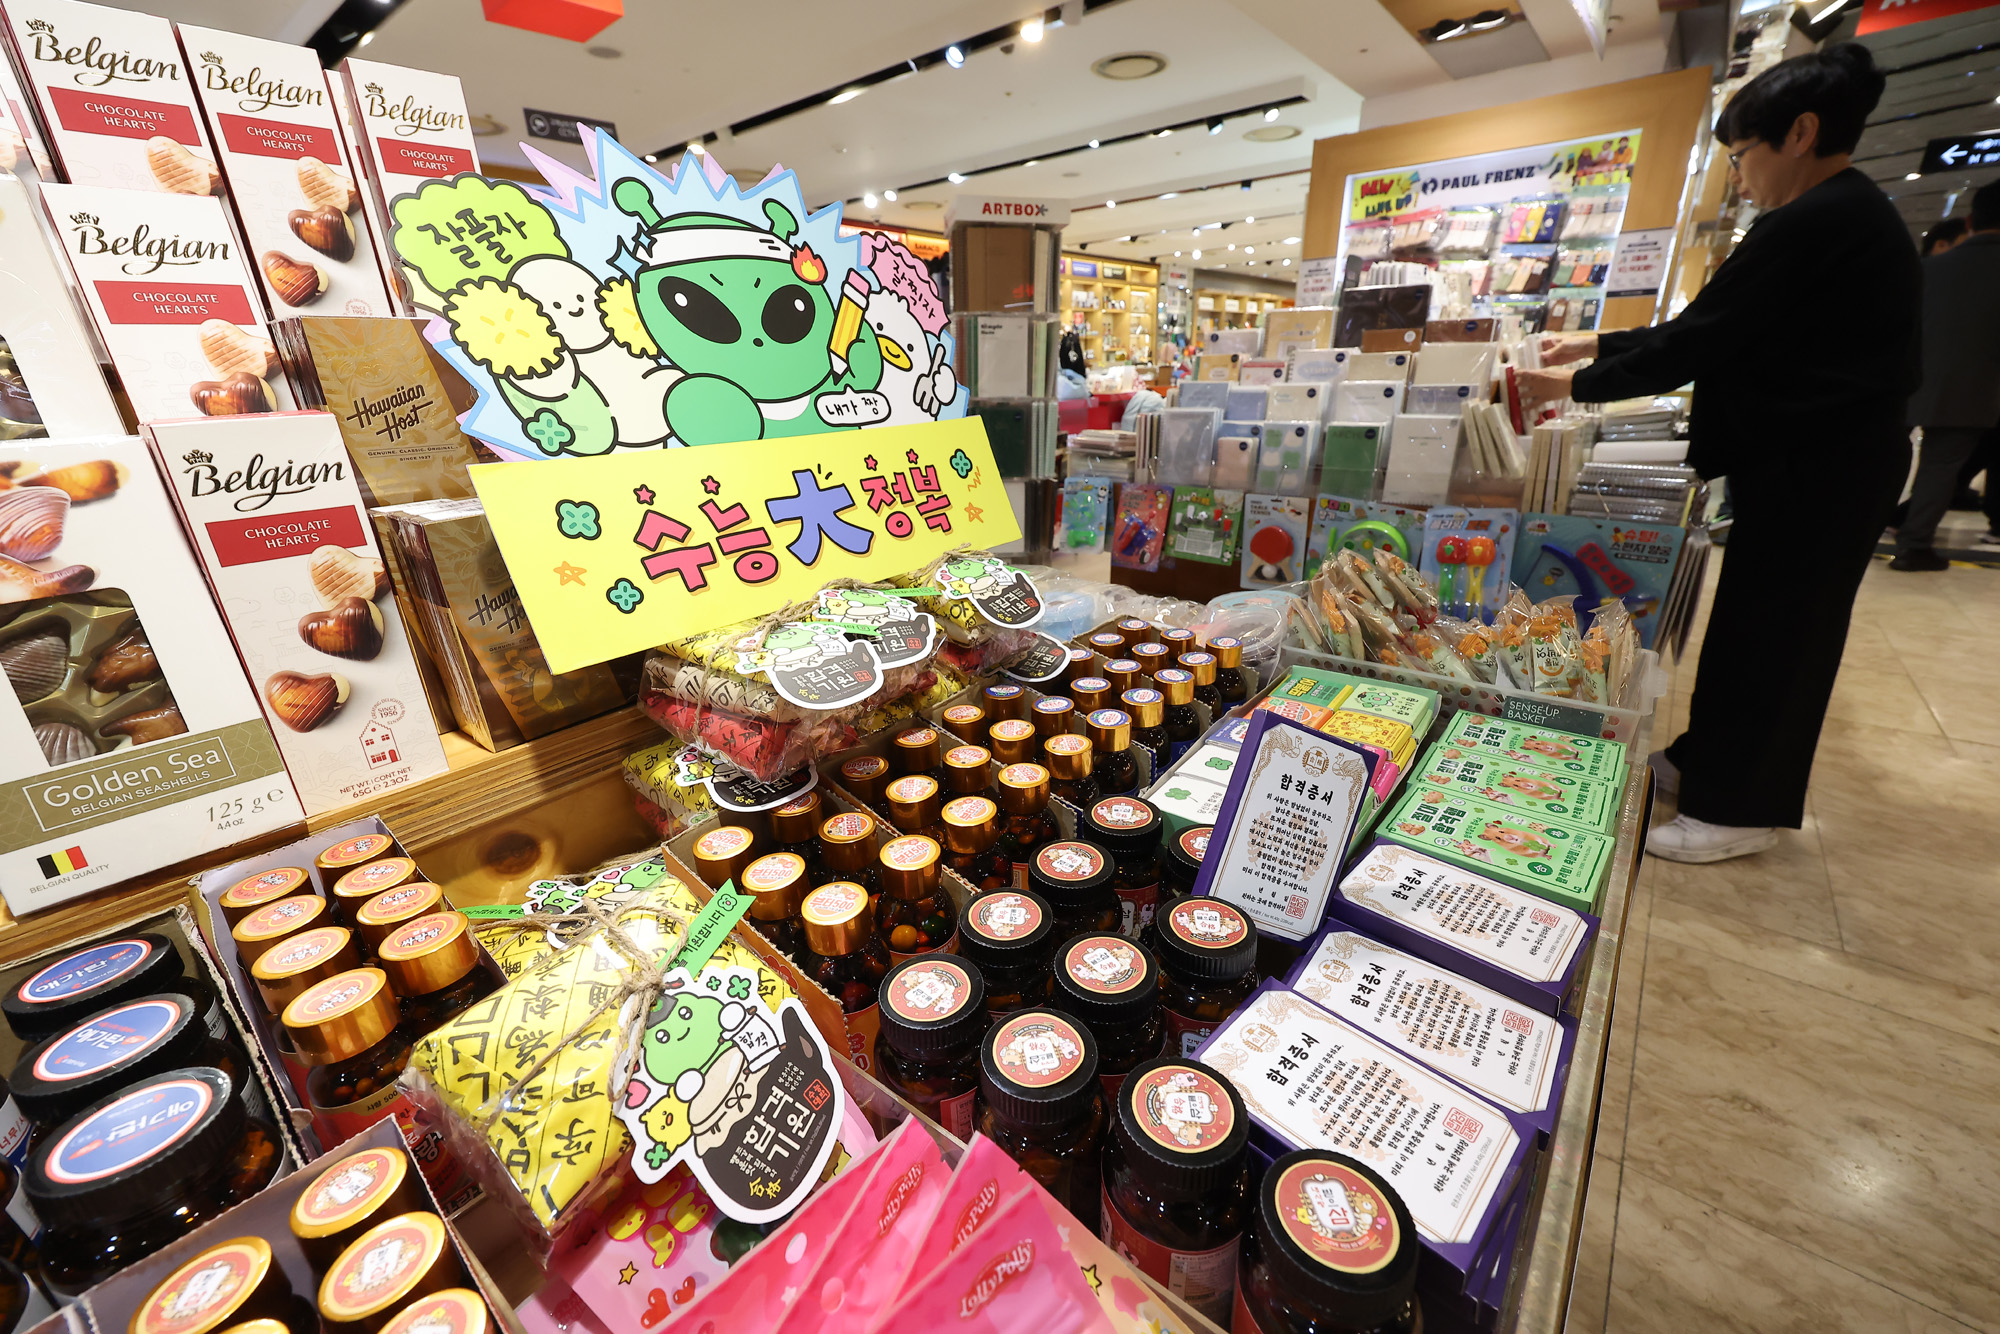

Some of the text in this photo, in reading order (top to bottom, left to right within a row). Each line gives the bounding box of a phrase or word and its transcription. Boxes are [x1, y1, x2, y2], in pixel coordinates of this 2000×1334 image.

[28, 32, 181, 86] Belgian
[201, 63, 322, 112] Belgian
[84, 102, 167, 122] CHOCOLATE
[104, 116, 156, 131] HEARTS
[365, 93, 465, 136] Belgian
[246, 126, 314, 144] CHOCOLATE
[262, 138, 305, 153] HEARTS
[399, 148, 455, 164] CHOCOLATE
[412, 159, 448, 172] HEARTS
[1441, 164, 1535, 190] PAUL FRENZ
[71, 223, 230, 275] Belgian
[133, 291, 219, 304] CHOCOLATE
[154, 303, 209, 315] HEARTS
[346, 384, 425, 428] Hawaiian
[376, 401, 433, 442] Host
[183, 454, 347, 512] Belgian
[245, 519, 331, 540] CHOCOLATE
[265, 533, 321, 549] HEARTS
[804, 662, 845, 683] 합격
[816, 673, 858, 691] 기원
[379, 710, 398, 718] 1956
[1507, 710, 1546, 725] BASKET
[1509, 700, 1560, 718] SENSE-UP
[42, 747, 222, 806] Golden Sea
[339, 784, 356, 794] NET
[352, 786, 372, 798] 65G
[383, 774, 410, 788] 2.3OZ
[1281, 774, 1333, 805] 합격증서
[71, 769, 212, 817] BELGIAN SEASHELLS
[206, 797, 244, 823] 125
[217, 816, 245, 831] 4.4 oz
[893, 842, 930, 865] 부터500
[30, 863, 110, 894] BELGIAN QUALITY
[749, 867, 794, 879] 부터500
[1391, 869, 1427, 900] 합격증서
[809, 896, 855, 910] 부터500
[683, 909, 726, 953] 기원합니다
[1350, 963, 1386, 1007] 합격증서
[740, 1031, 769, 1049] 합격
[1266, 1033, 1319, 1086] 합격증서
[1294, 1083, 1309, 1099] 사람은
[1307, 1063, 1325, 1083] 밤낮없이
[1322, 1045, 1344, 1063] 공부하고,
[384, 1089, 398, 1103] 500
[1309, 1060, 1347, 1103] 남다른 노력과 집념,
[1320, 1095, 1336, 1113] 뜨거운
[1333, 1079, 1348, 1095] 열정과
[743, 1085, 794, 1155] 합격
[1320, 1112, 1341, 1136] 누구보다
[1338, 1095, 1354, 1112] 뛰어난
[1351, 1080, 1366, 1095] 실력을
[1334, 1068, 1394, 1145] 매시간 노력과 최선을 다했습니다.
[1349, 1124, 1369, 1149] 평소보다
[1371, 1106, 1384, 1118] 높은
[1380, 1089, 1396, 1105] 점수를
[1392, 1078, 1403, 1089] 받아
[1385, 1108, 1401, 1125] 원하는
[1397, 1095, 1409, 1108] 곳에
[767, 1101, 817, 1162] 기원
[1388, 1108, 1419, 1149] 합격할 것이기에
[1391, 1162, 1403, 1176] 미리
[1404, 1131, 1424, 1154] 합격증을
[1420, 1103, 1441, 1130] 수여합니다.
[749, 1176, 782, 1200] 合格
[1434, 1175, 1449, 1192] 원하는
[1444, 1160, 1456, 1175] 곳에
[877, 1160, 925, 1236] LollyPolly
[959, 1238, 1034, 1318] LollyPolly
